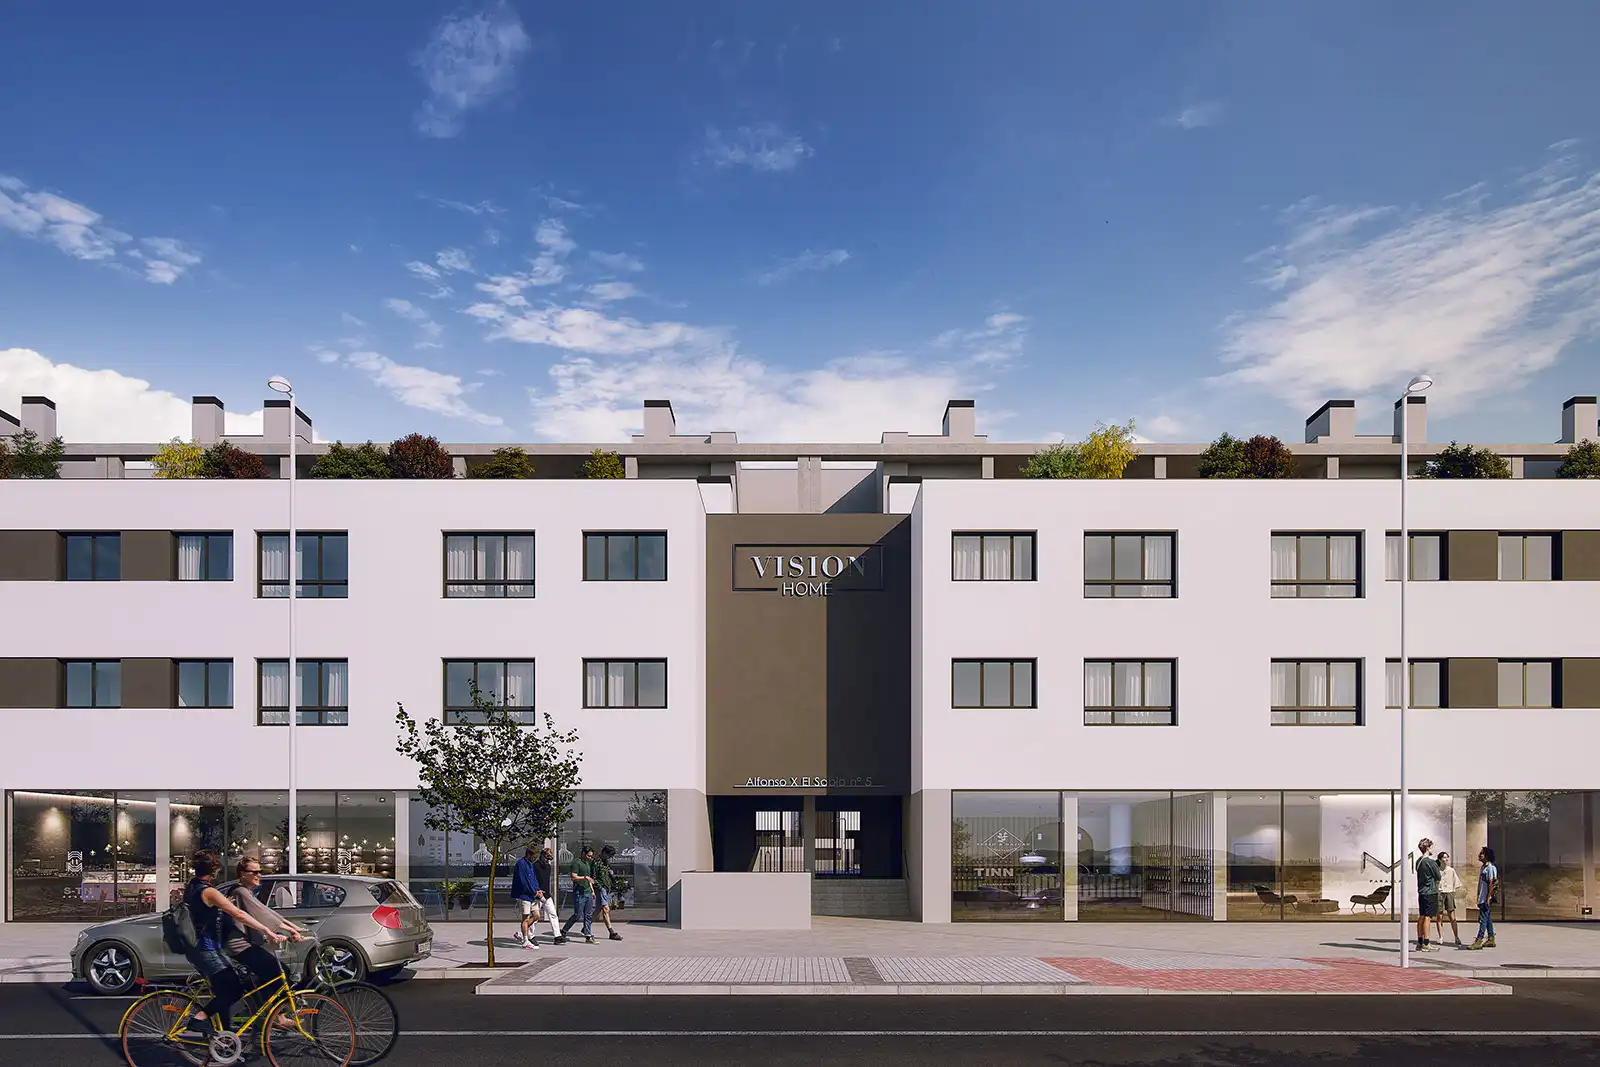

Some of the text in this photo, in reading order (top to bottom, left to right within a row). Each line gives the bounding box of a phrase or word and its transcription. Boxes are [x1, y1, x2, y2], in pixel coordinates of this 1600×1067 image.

[750, 555, 867, 578] VISION
[782, 581, 834, 596] HOME
[745, 776, 787, 787] Alfonso
[790, 777, 798, 787] X
[802, 776, 811, 787] El
[865, 776, 873, 787] 5
[973, 867, 1014, 877] TINN
